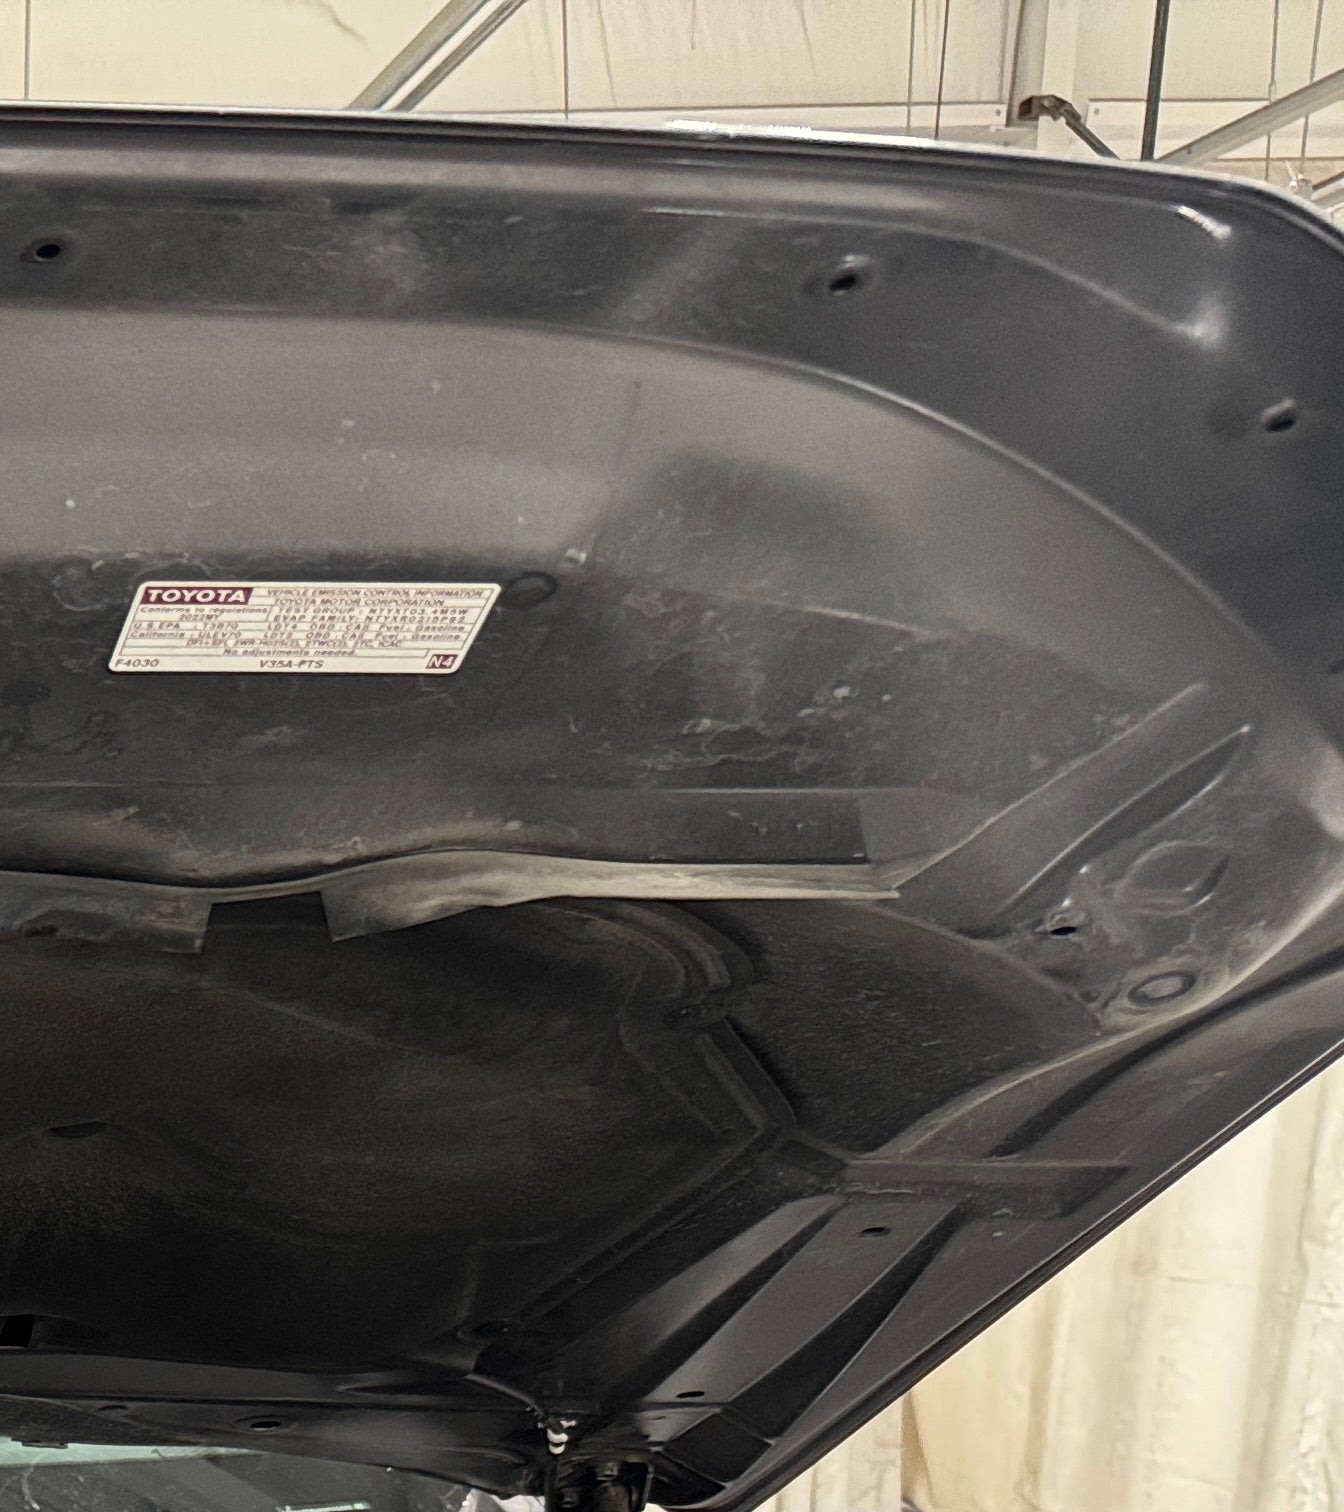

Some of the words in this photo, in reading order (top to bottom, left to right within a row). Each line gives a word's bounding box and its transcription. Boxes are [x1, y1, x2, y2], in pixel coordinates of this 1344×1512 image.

[147, 589, 246, 603] TOYOTA
[140, 606, 191, 614] Conforms
[195, 606, 204, 614] to
[208, 606, 268, 616] regulations
[130, 631, 185, 639] California
[241, 649, 310, 658] adjustments
[114, 659, 160, 668] F4030
[428, 655, 454, 668] N4
